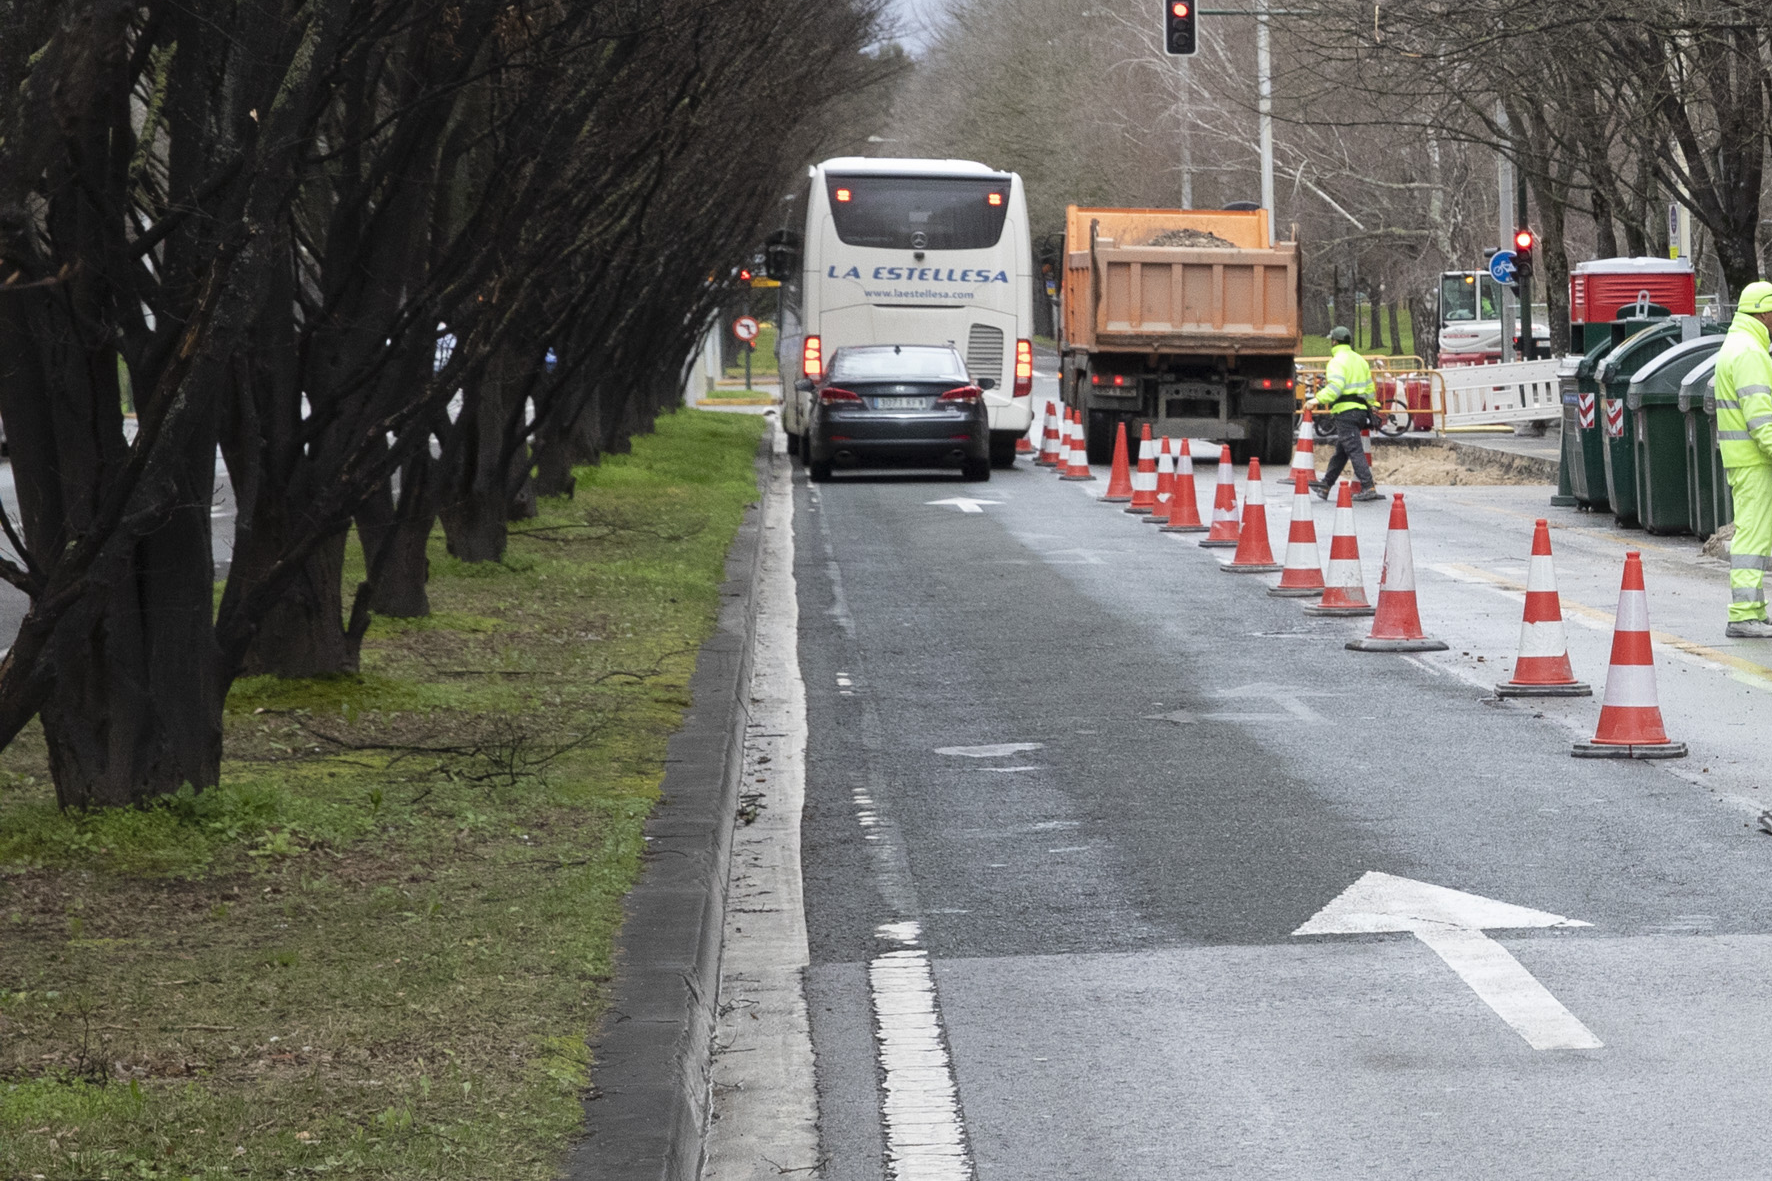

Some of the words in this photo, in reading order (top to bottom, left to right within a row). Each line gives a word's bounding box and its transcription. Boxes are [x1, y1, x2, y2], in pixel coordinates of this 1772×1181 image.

[827, 265, 861, 279] LA
[872, 266, 1009, 284] ESTELLESA
[864, 289, 975, 300] www.laestellesa.com
